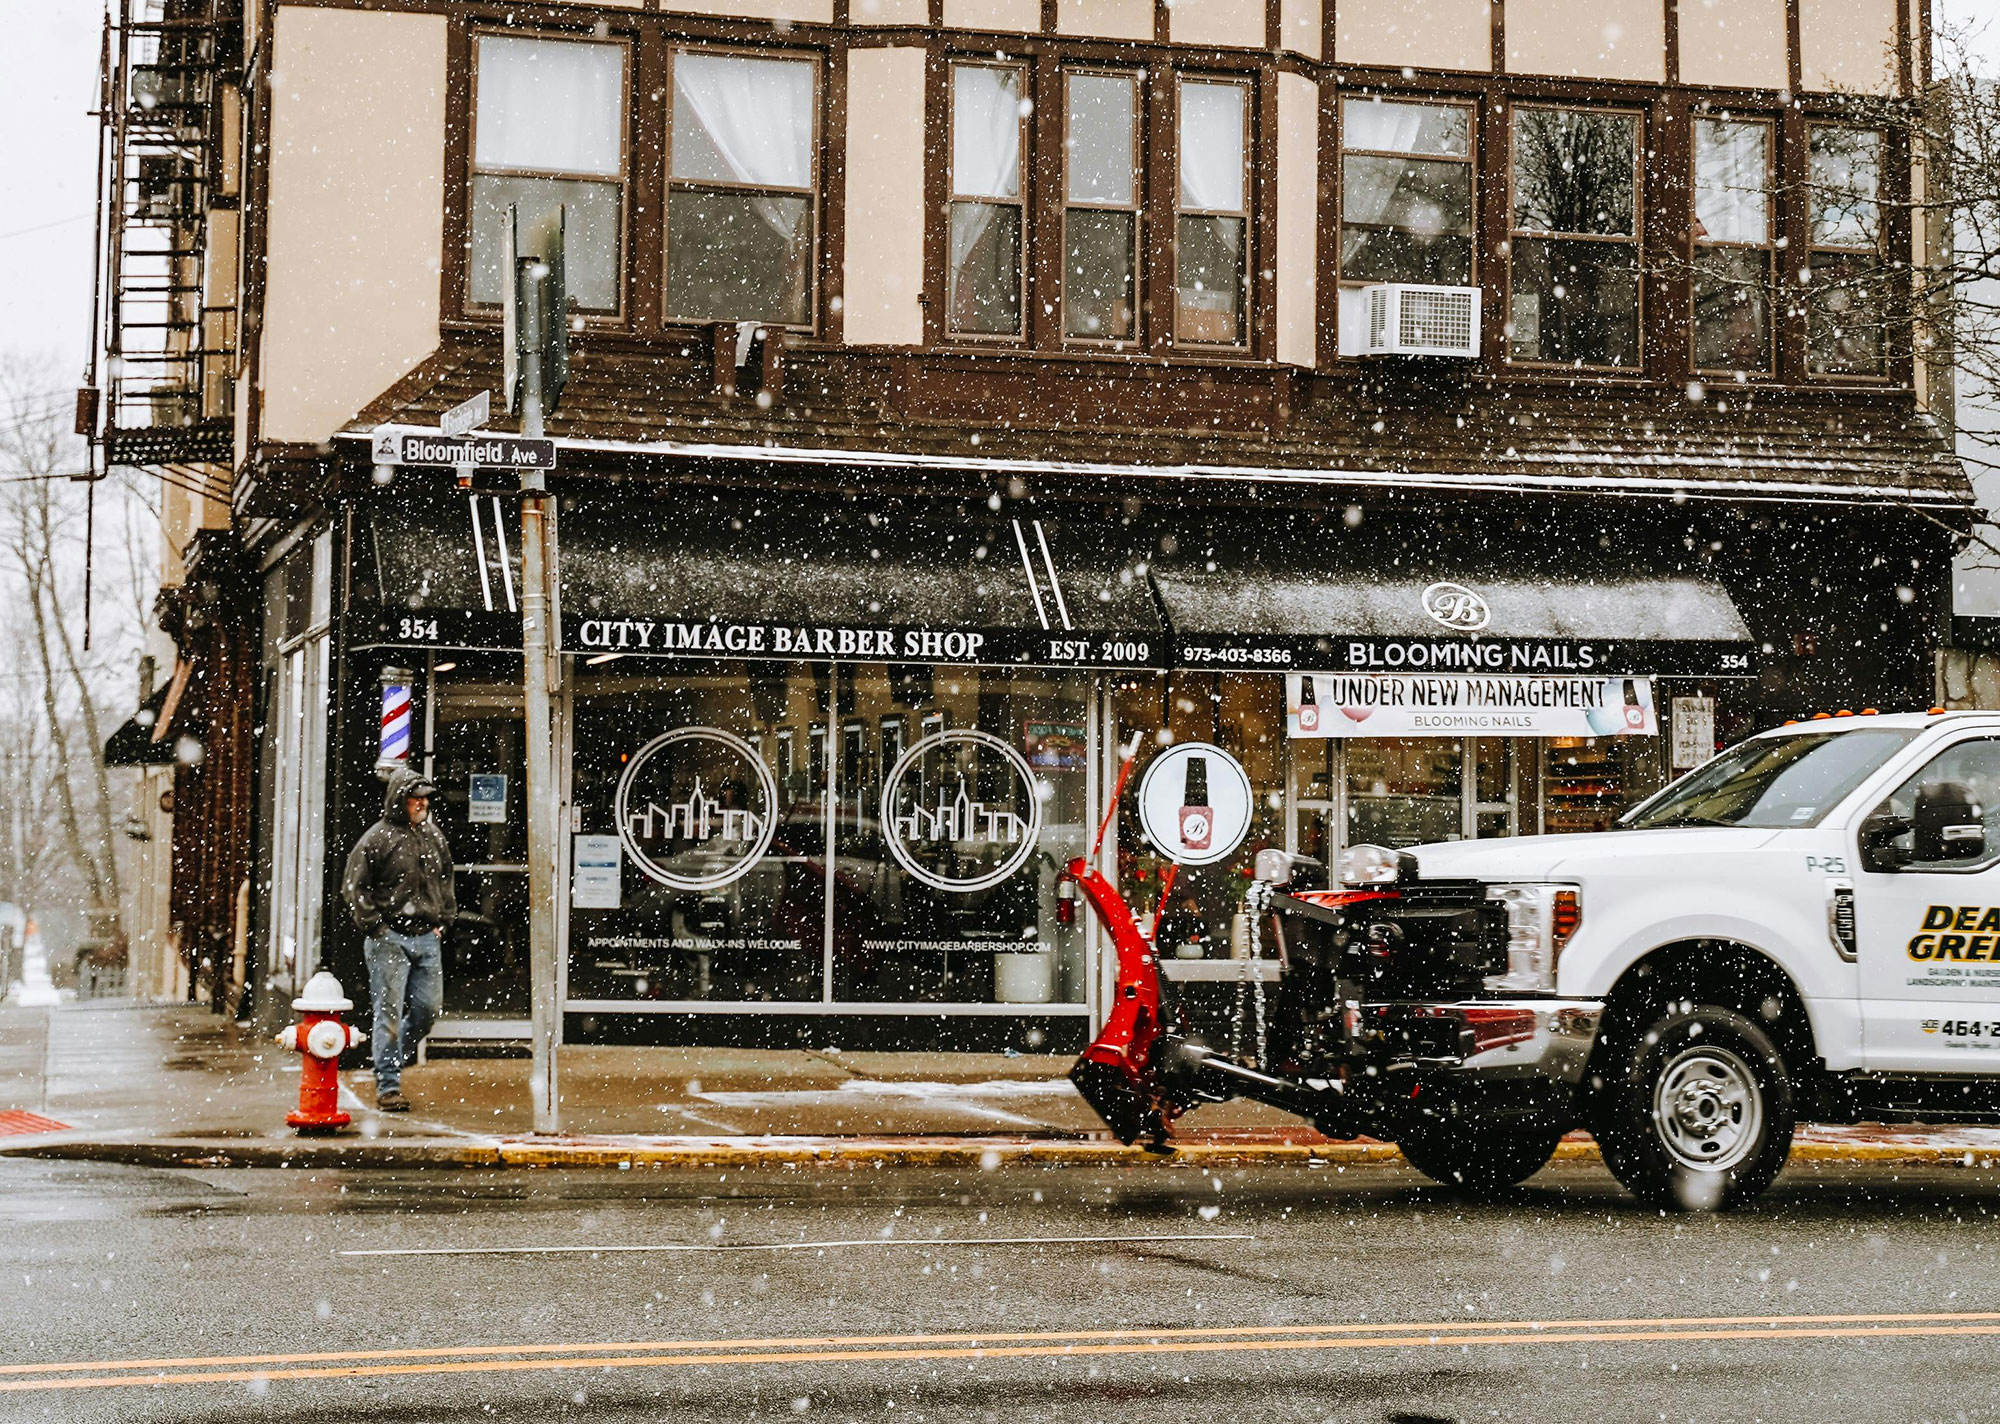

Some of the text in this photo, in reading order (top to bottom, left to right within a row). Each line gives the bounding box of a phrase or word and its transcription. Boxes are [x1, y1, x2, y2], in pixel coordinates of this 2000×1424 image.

[406, 438, 538, 465] Bloomfield Ave
[398, 617, 439, 641] 354
[579, 620, 985, 659] CITY IMAGE BARBER SHOP
[1049, 639, 1150, 662] EST. 2009
[1183, 646, 1292, 664] 973-403-8366
[1348, 641, 1596, 669] BLOOMING NAILS
[1720, 654, 1748, 669] 354
[1333, 678, 1606, 708] UNDER NEW MANAGEMENT
[1414, 715, 1532, 728] BLOOMING NAILS
[1806, 856, 1846, 873] P-25
[587, 937, 802, 950] APPOINTMENTS AND WALK-INS WELCOME
[865, 939, 1052, 952] WWW.CITYIMAGEBARBERSHOP.COM
